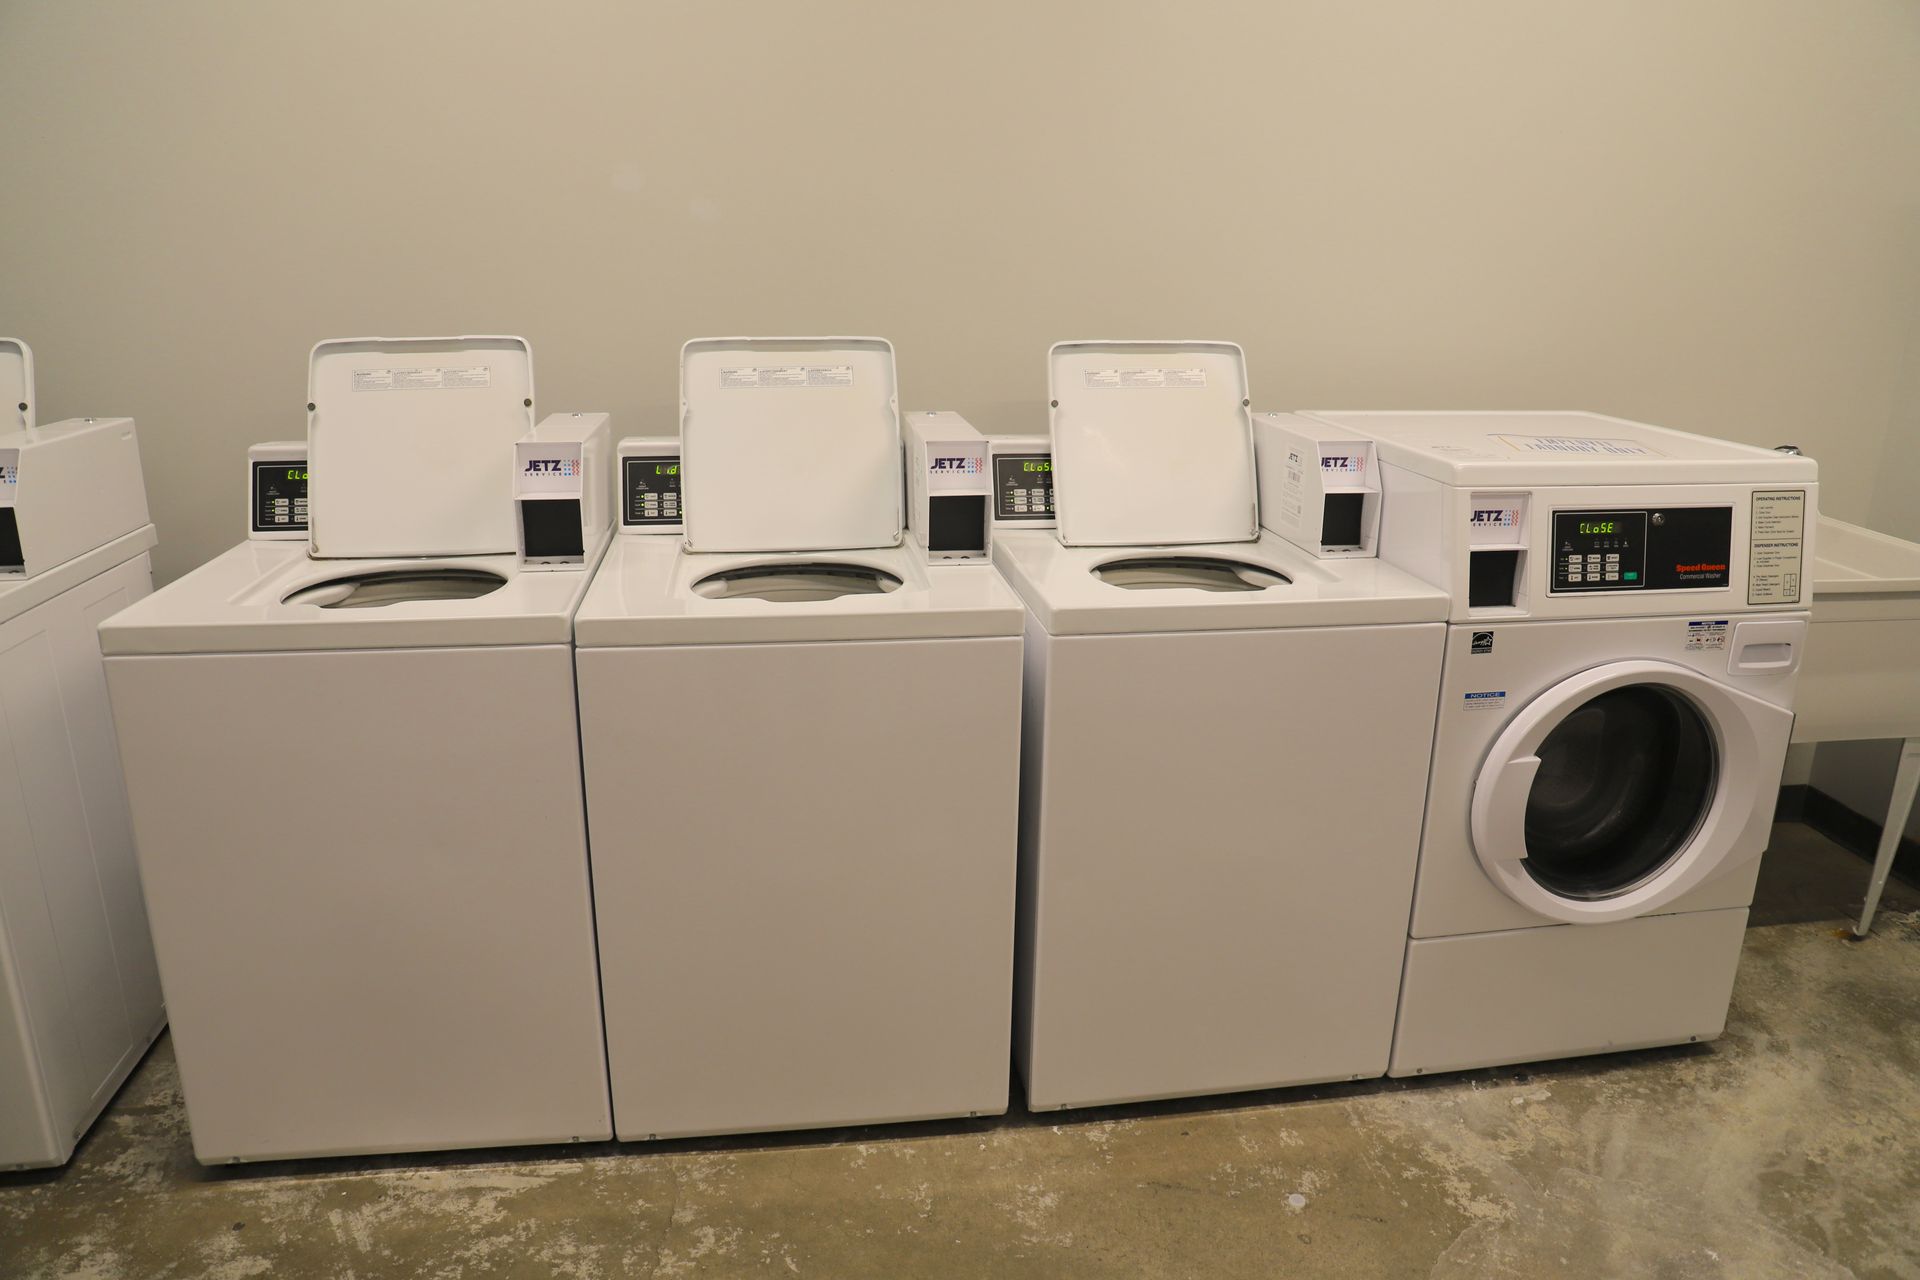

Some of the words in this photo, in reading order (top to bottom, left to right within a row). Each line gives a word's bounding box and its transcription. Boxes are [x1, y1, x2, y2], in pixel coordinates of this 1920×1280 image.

[525, 460, 561, 471] JETZ
[931, 458, 965, 469] JETZ
[1470, 510, 1503, 522] JETZ
[1676, 563, 1700, 573] Speed
[1701, 563, 1726, 571] Queen
